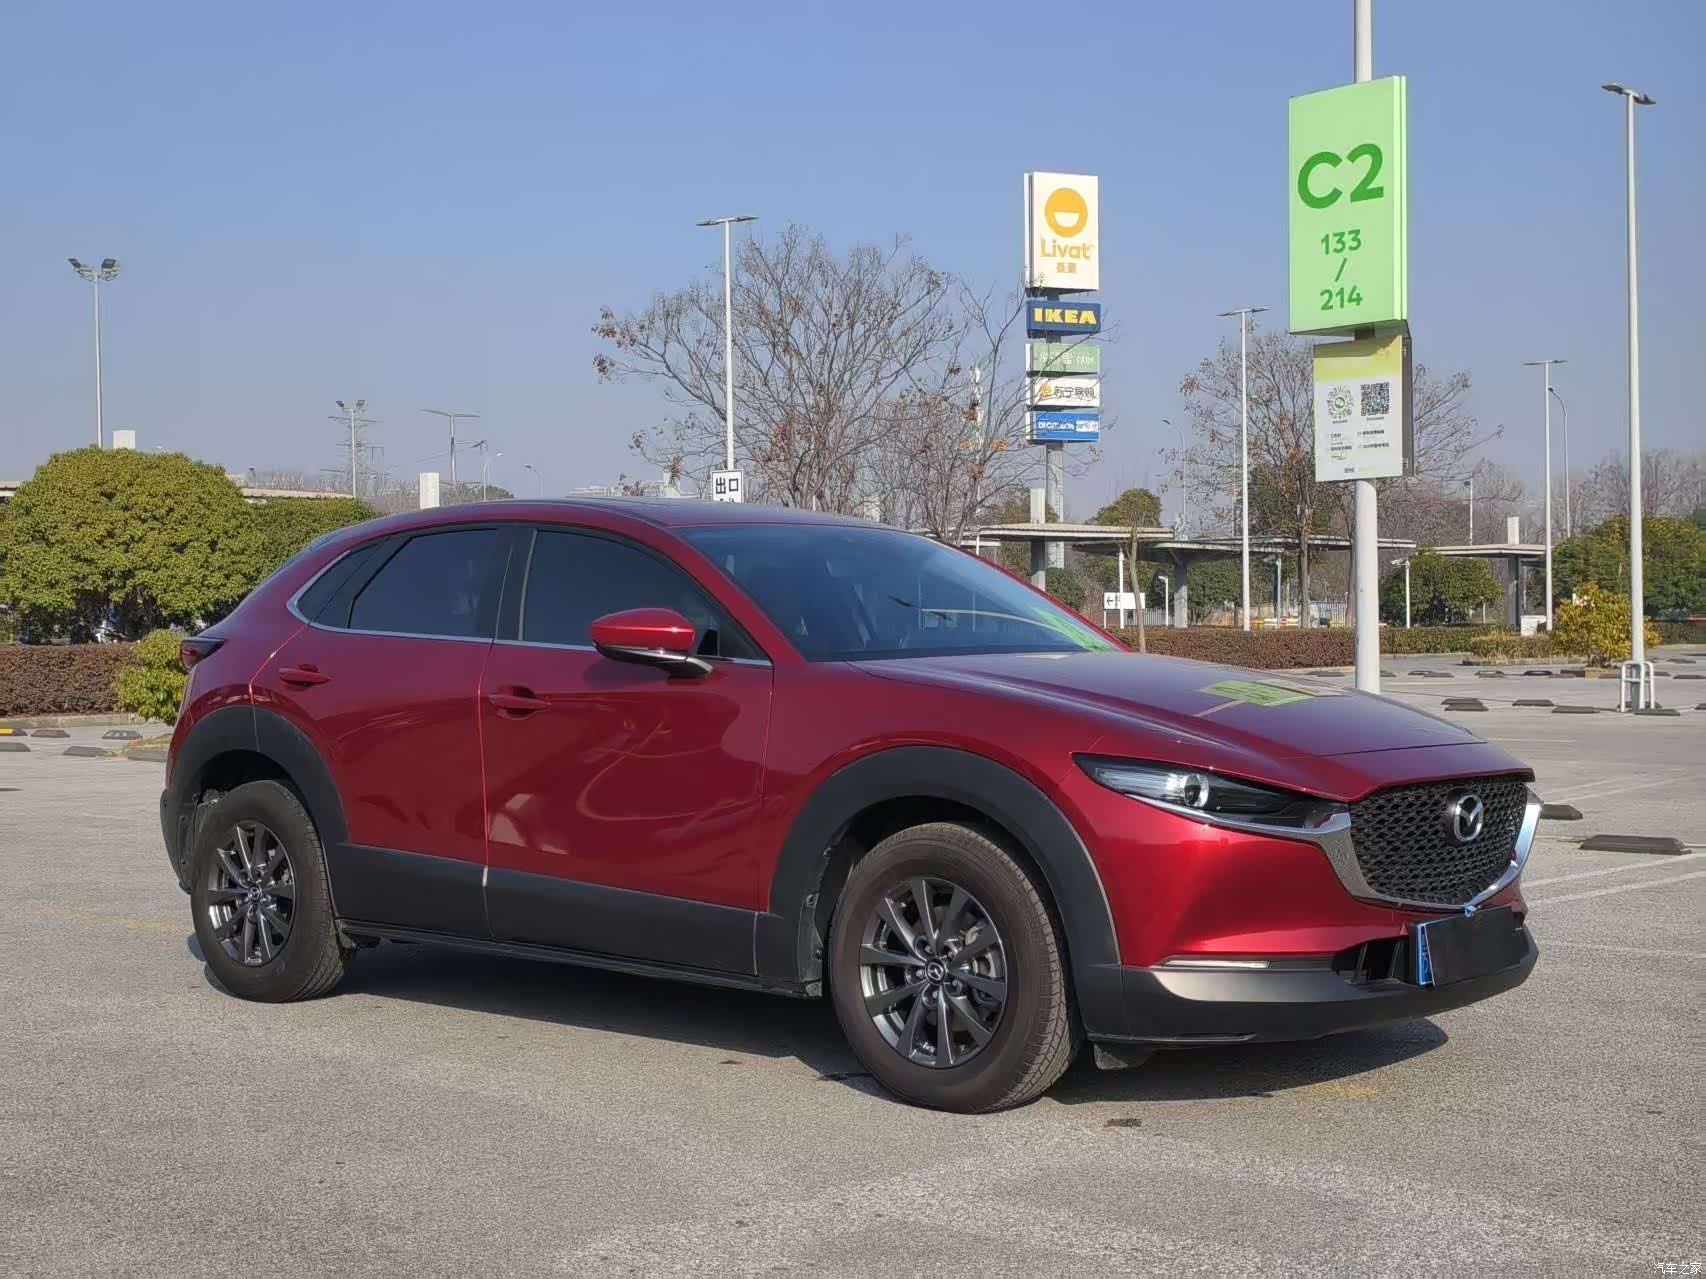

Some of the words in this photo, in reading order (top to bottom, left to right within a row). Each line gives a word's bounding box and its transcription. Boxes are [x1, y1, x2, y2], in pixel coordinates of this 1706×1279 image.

[1297, 143, 1385, 210] C2
[1040, 238, 1091, 260] Livat
[1320, 229, 1362, 255] 133
[1334, 257, 1348, 282] /
[1320, 284, 1363, 311] 214
[1034, 307, 1097, 325] IKEA
[715, 476, 739, 495] 出口
